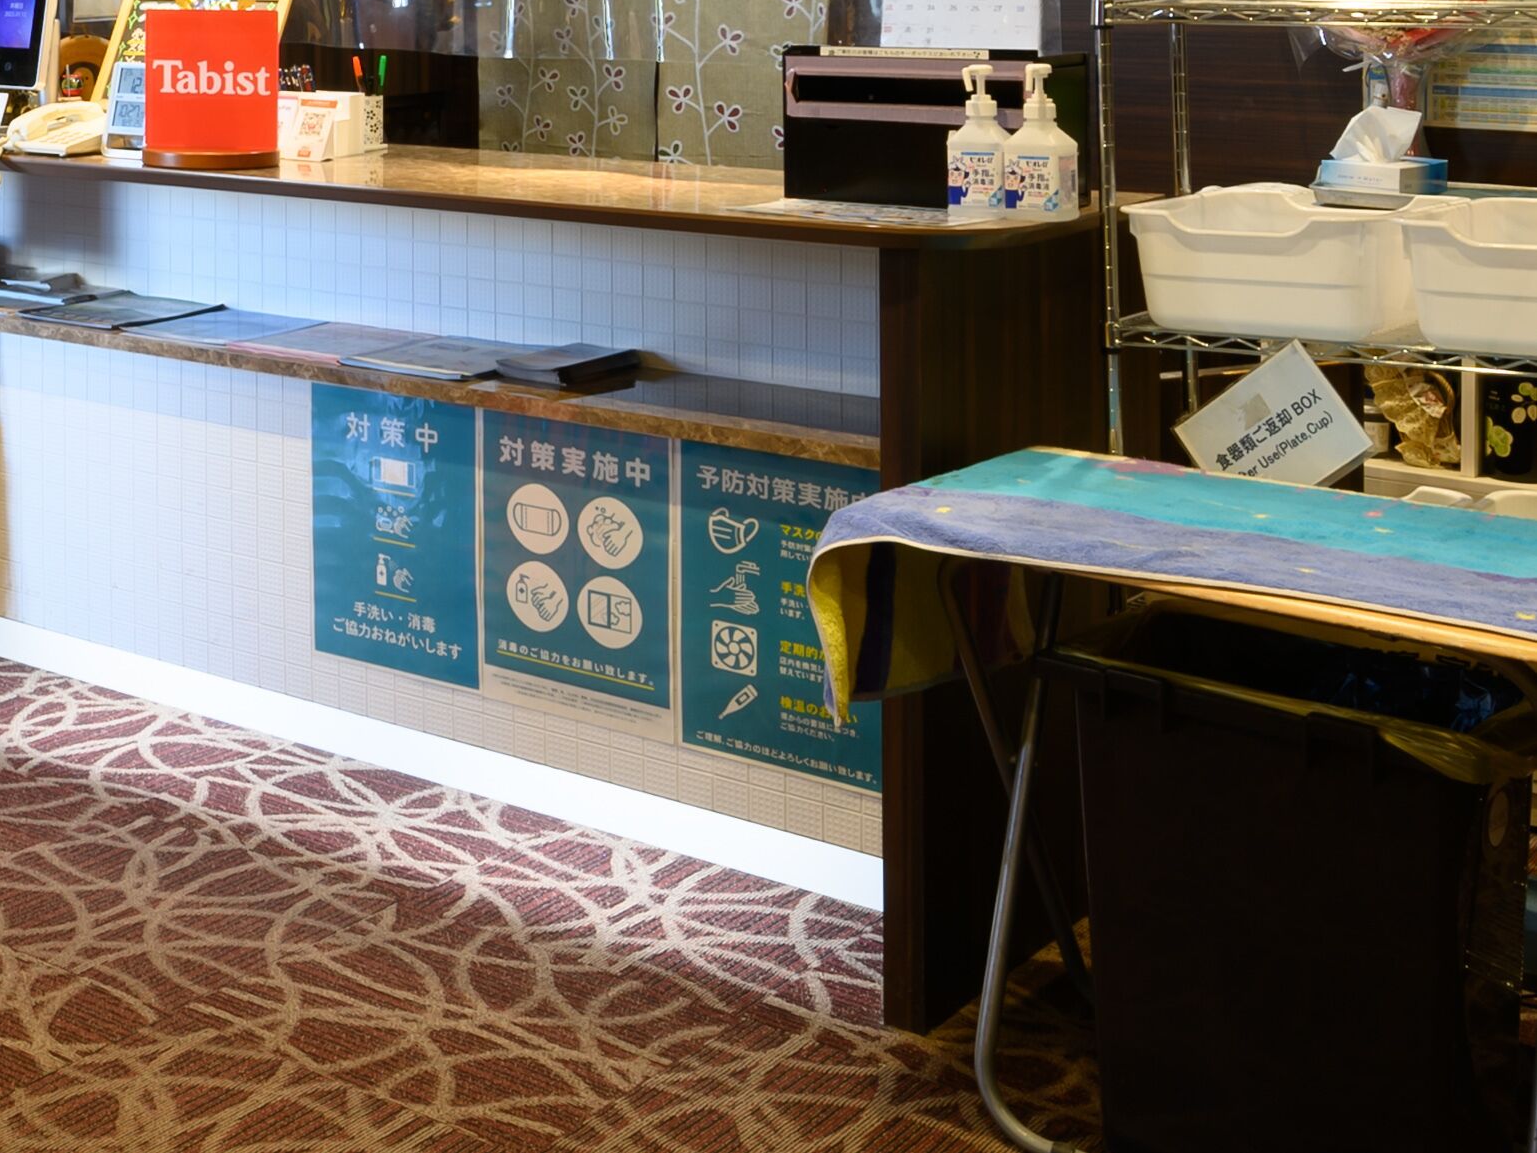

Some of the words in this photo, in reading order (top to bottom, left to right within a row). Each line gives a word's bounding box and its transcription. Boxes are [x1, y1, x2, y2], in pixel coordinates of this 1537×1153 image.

[152, 58, 271, 96] Tabist
[346, 412, 439, 454] 対策中
[1216, 408, 1293, 471] 食器類ご返却
[1291, 388, 1322, 416] BOX
[1258, 410, 1334, 469] Use(Plate,Cup)
[499, 435, 651, 488] 対策実施中
[333, 616, 462, 660] ご協力おねがいします
[353, 601, 436, 634] 手洗い・消毒
